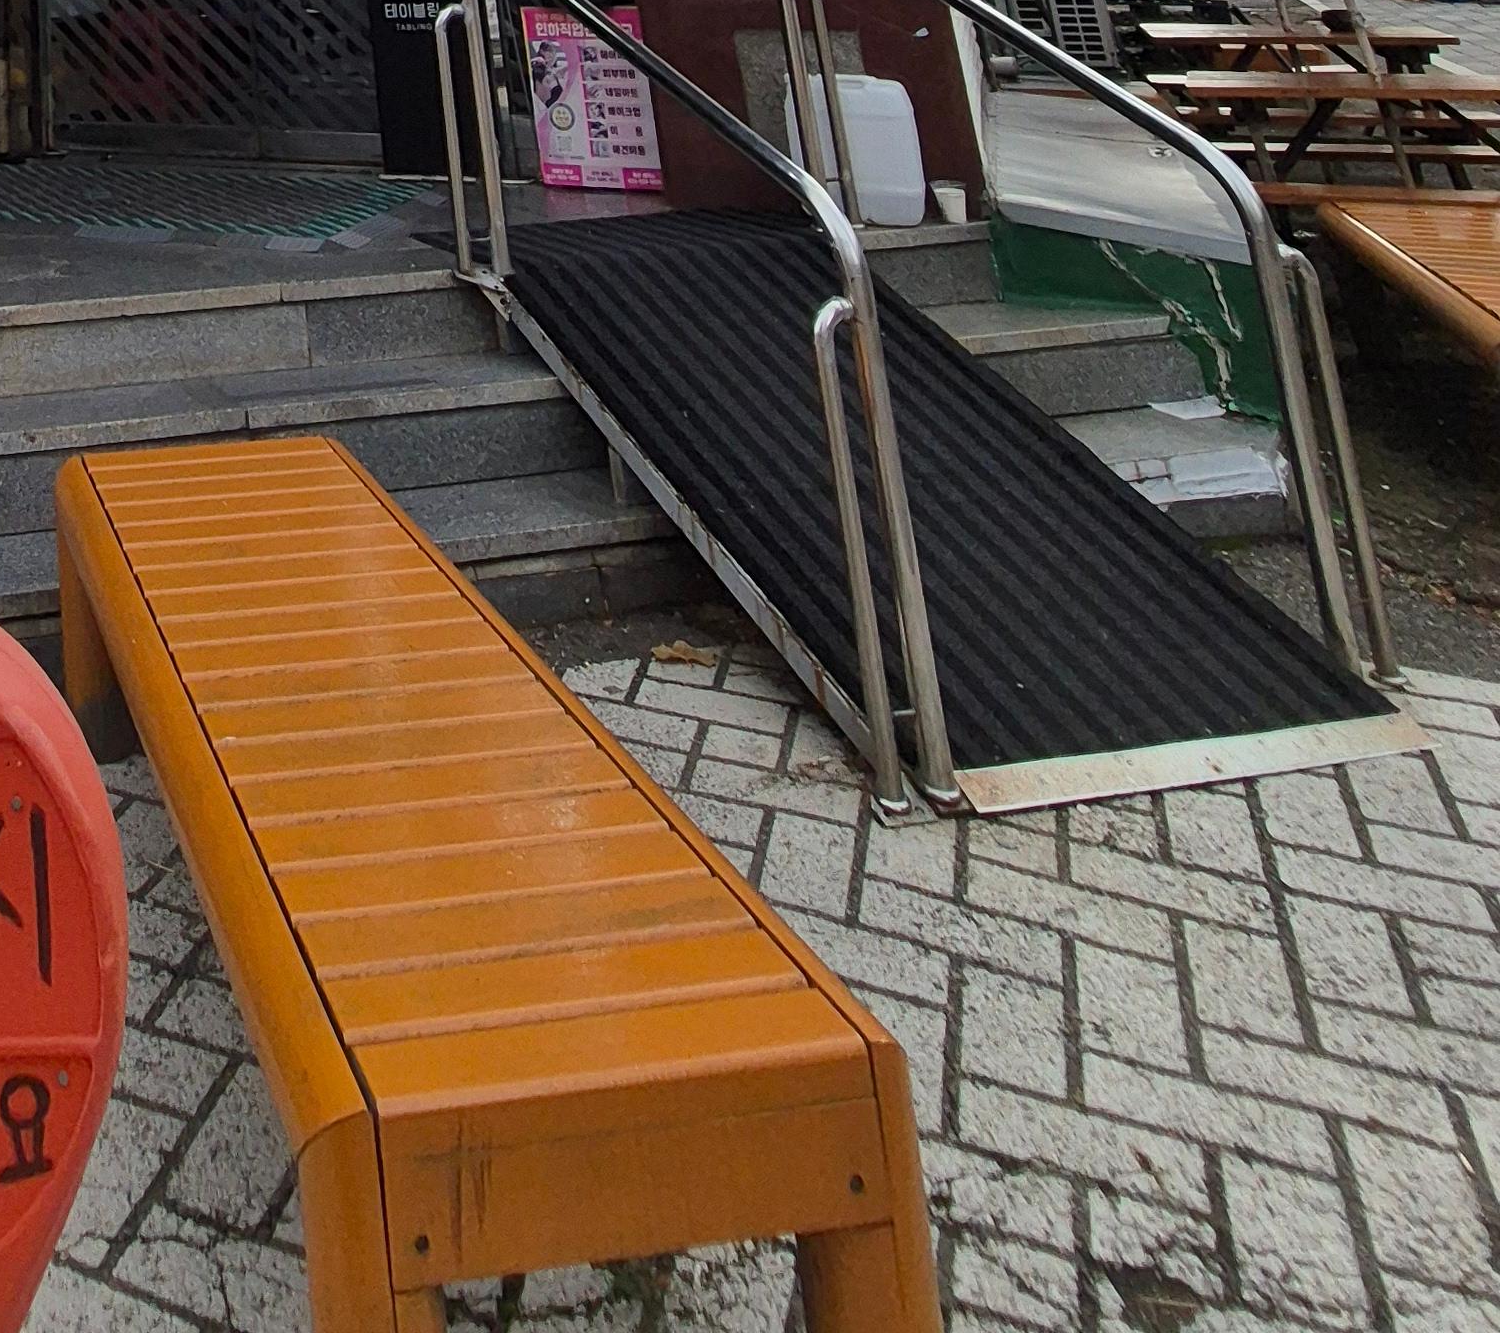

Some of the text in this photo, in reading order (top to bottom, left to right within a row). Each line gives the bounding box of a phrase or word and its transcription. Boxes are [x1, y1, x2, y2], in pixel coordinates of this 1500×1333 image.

[384, 1, 440, 19] 테이블링
[602, 68, 636, 80] 피부미용
[605, 87, 639, 99] 네일아트
[607, 106, 642, 118] 메이크업
